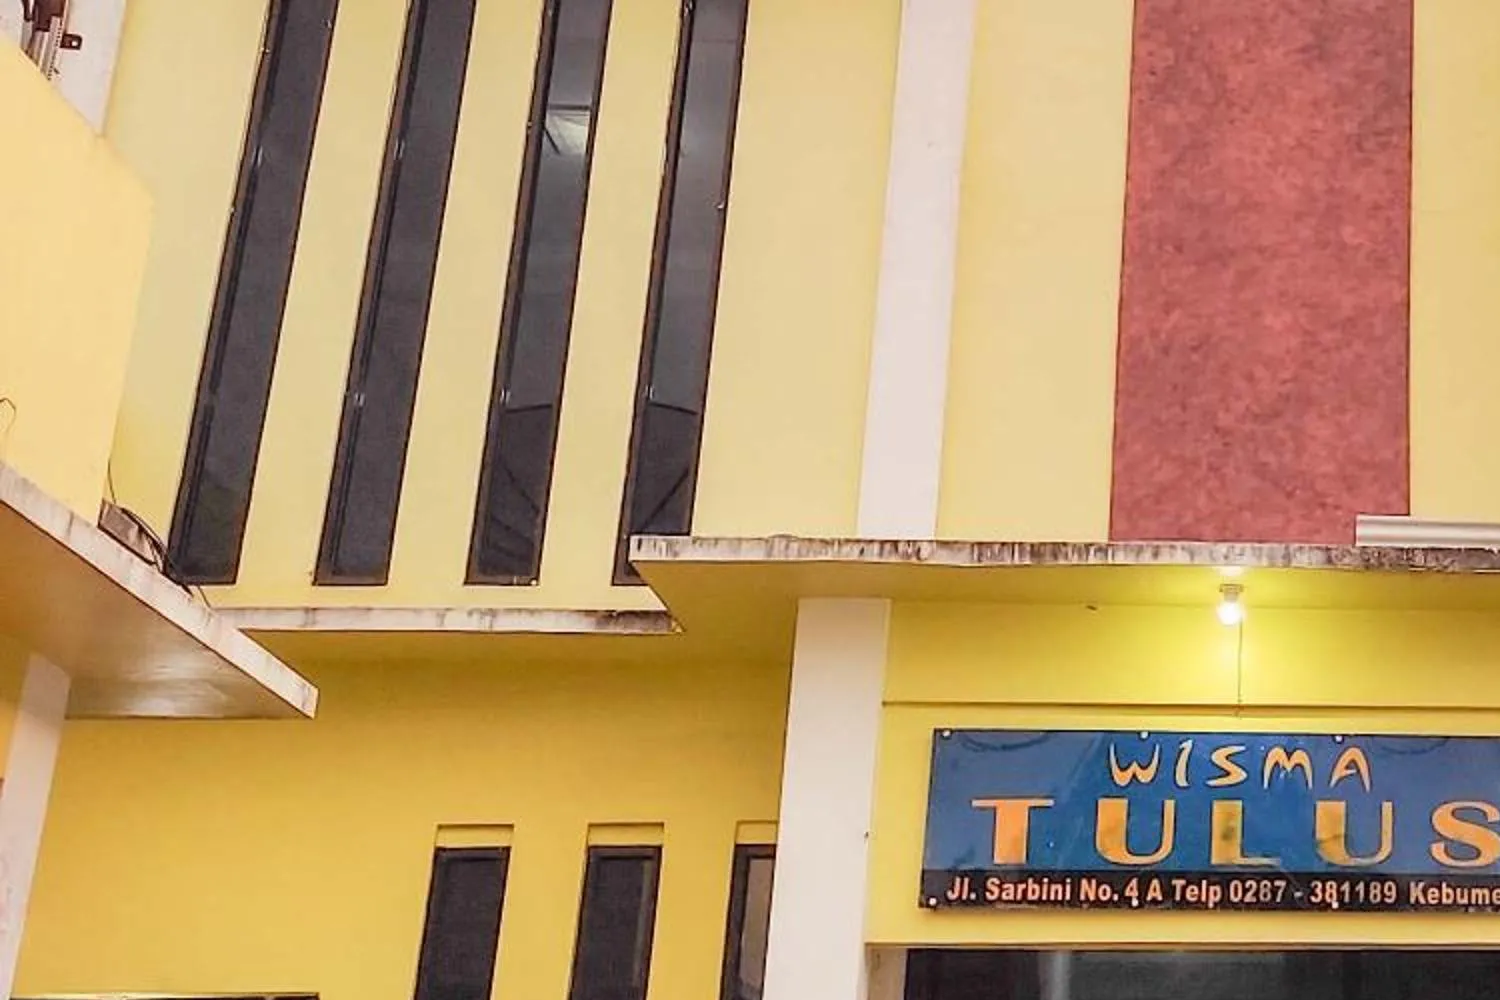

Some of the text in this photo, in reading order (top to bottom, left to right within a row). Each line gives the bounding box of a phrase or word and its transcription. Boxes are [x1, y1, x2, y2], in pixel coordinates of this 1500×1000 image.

[1110, 740, 1371, 792] WISMA
[947, 877, 976, 899] Jl.
[985, 877, 1071, 900] Sarbini
[1079, 878, 1118, 901] No.
[1125, 878, 1139, 902] 4
[1146, 880, 1163, 901] A
[1172, 879, 1221, 907] Telp
[1229, 880, 1286, 902] 0287
[1310, 880, 1397, 904] 381189
